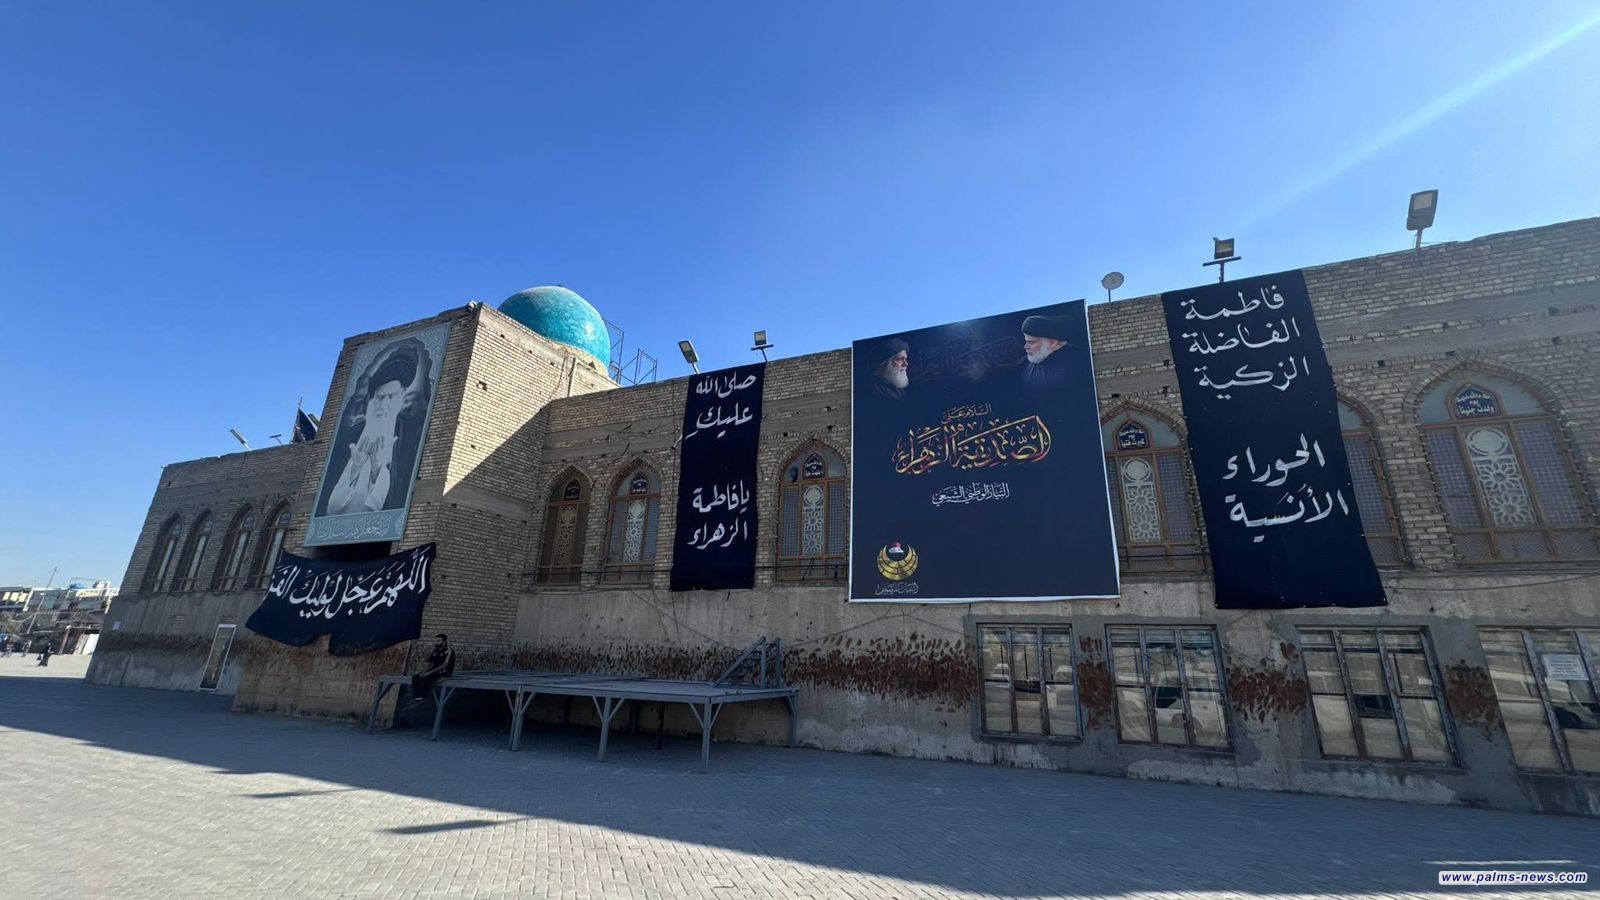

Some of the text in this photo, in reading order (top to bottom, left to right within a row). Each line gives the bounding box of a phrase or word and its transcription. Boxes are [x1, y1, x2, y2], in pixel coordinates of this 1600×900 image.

[1180, 285, 1284, 320] فاطمة
[1181, 316, 1300, 355] الفاضلة
[1193, 356, 1310, 400] الزكية
[1222, 432, 1325, 487] الحوراء
[961, 482, 988, 504] الوطني
[985, 482, 1010, 500] التيار
[687, 517, 748, 550] الزهراء
